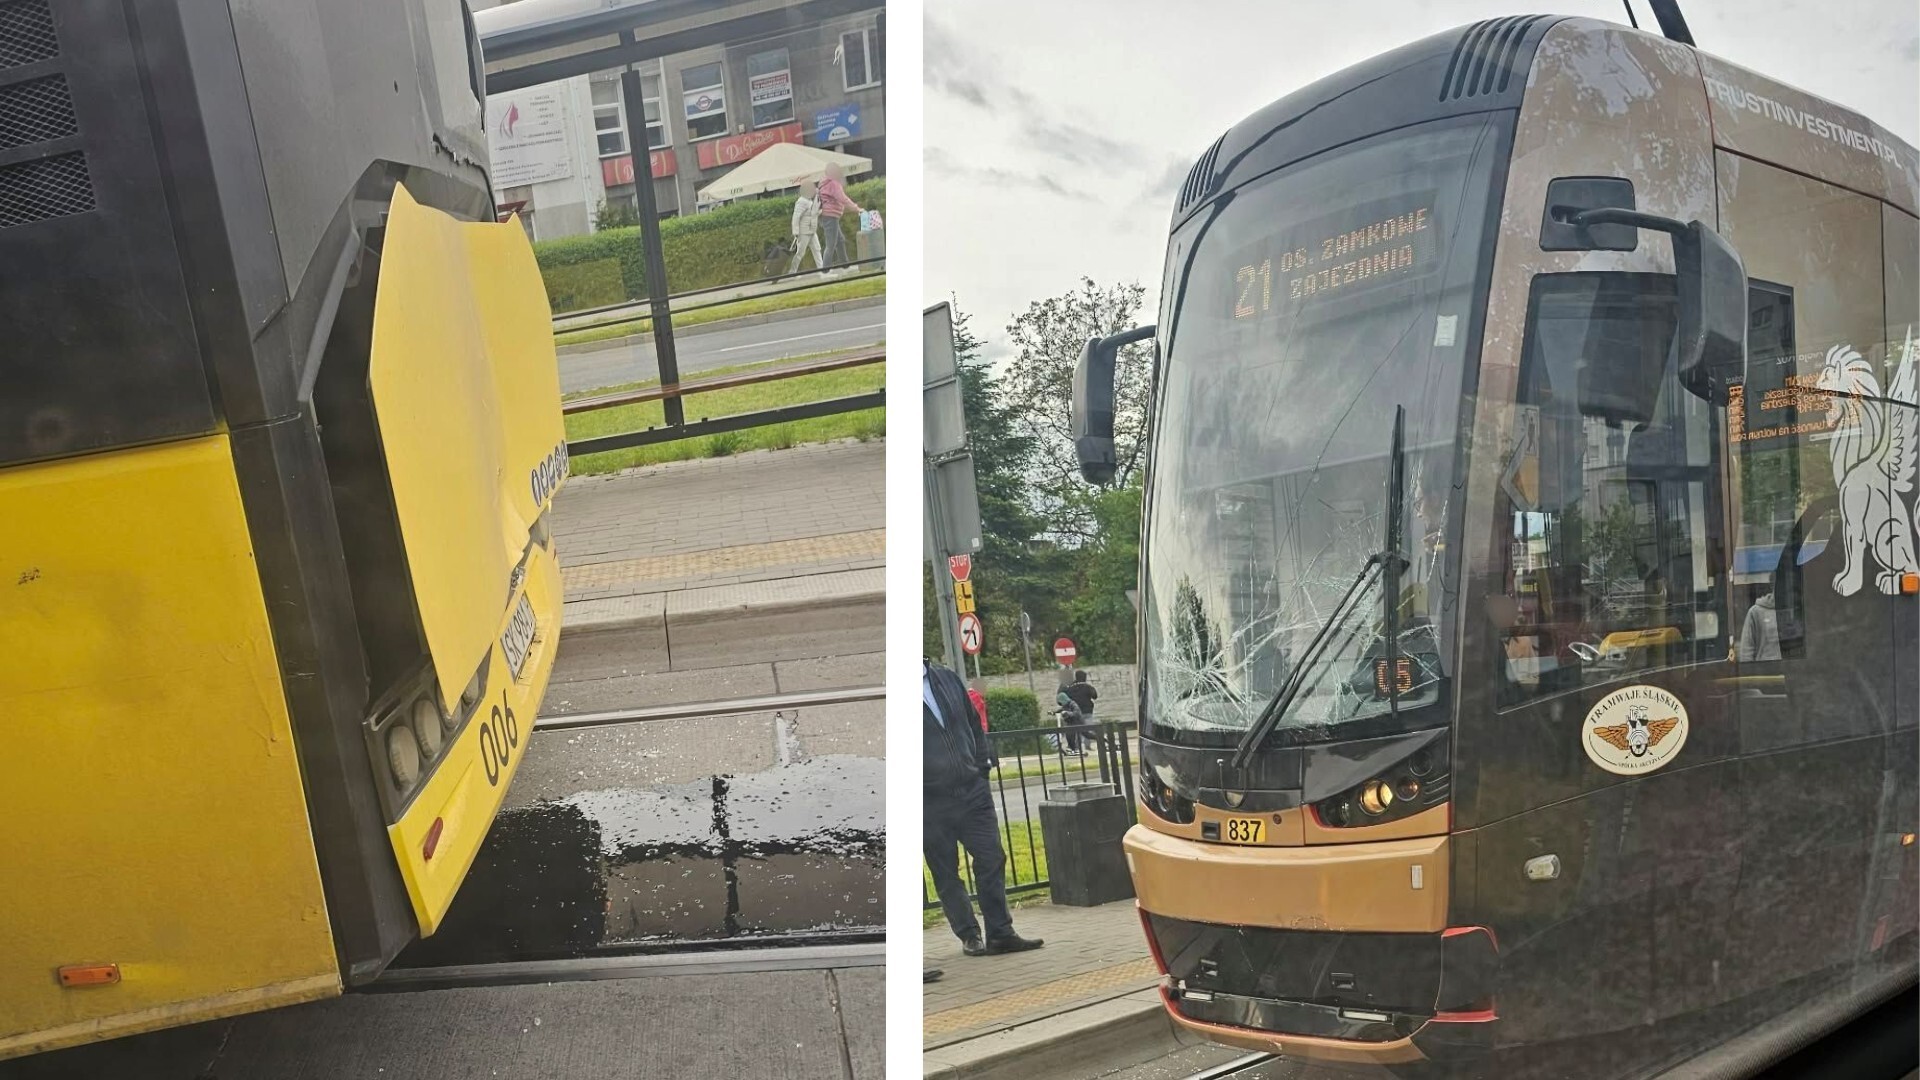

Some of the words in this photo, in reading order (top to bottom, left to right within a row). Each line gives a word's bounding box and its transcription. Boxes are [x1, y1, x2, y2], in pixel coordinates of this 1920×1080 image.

[1702, 75, 1902, 170] TRUSTINVESTMENT.PL
[1280, 248, 1314, 272] OS.
[1321, 208, 1428, 261] ZAMKOWE
[1234, 258, 1271, 319] 21
[1290, 245, 1413, 300] ZAJEZDNIA
[950, 554, 968, 568] STOP
[1589, 689, 1641, 724] TRAMWAJE
[1643, 687, 1681, 714] ŚLĄSKIE
[479, 688, 518, 787] 006
[1228, 819, 1262, 842] 837
